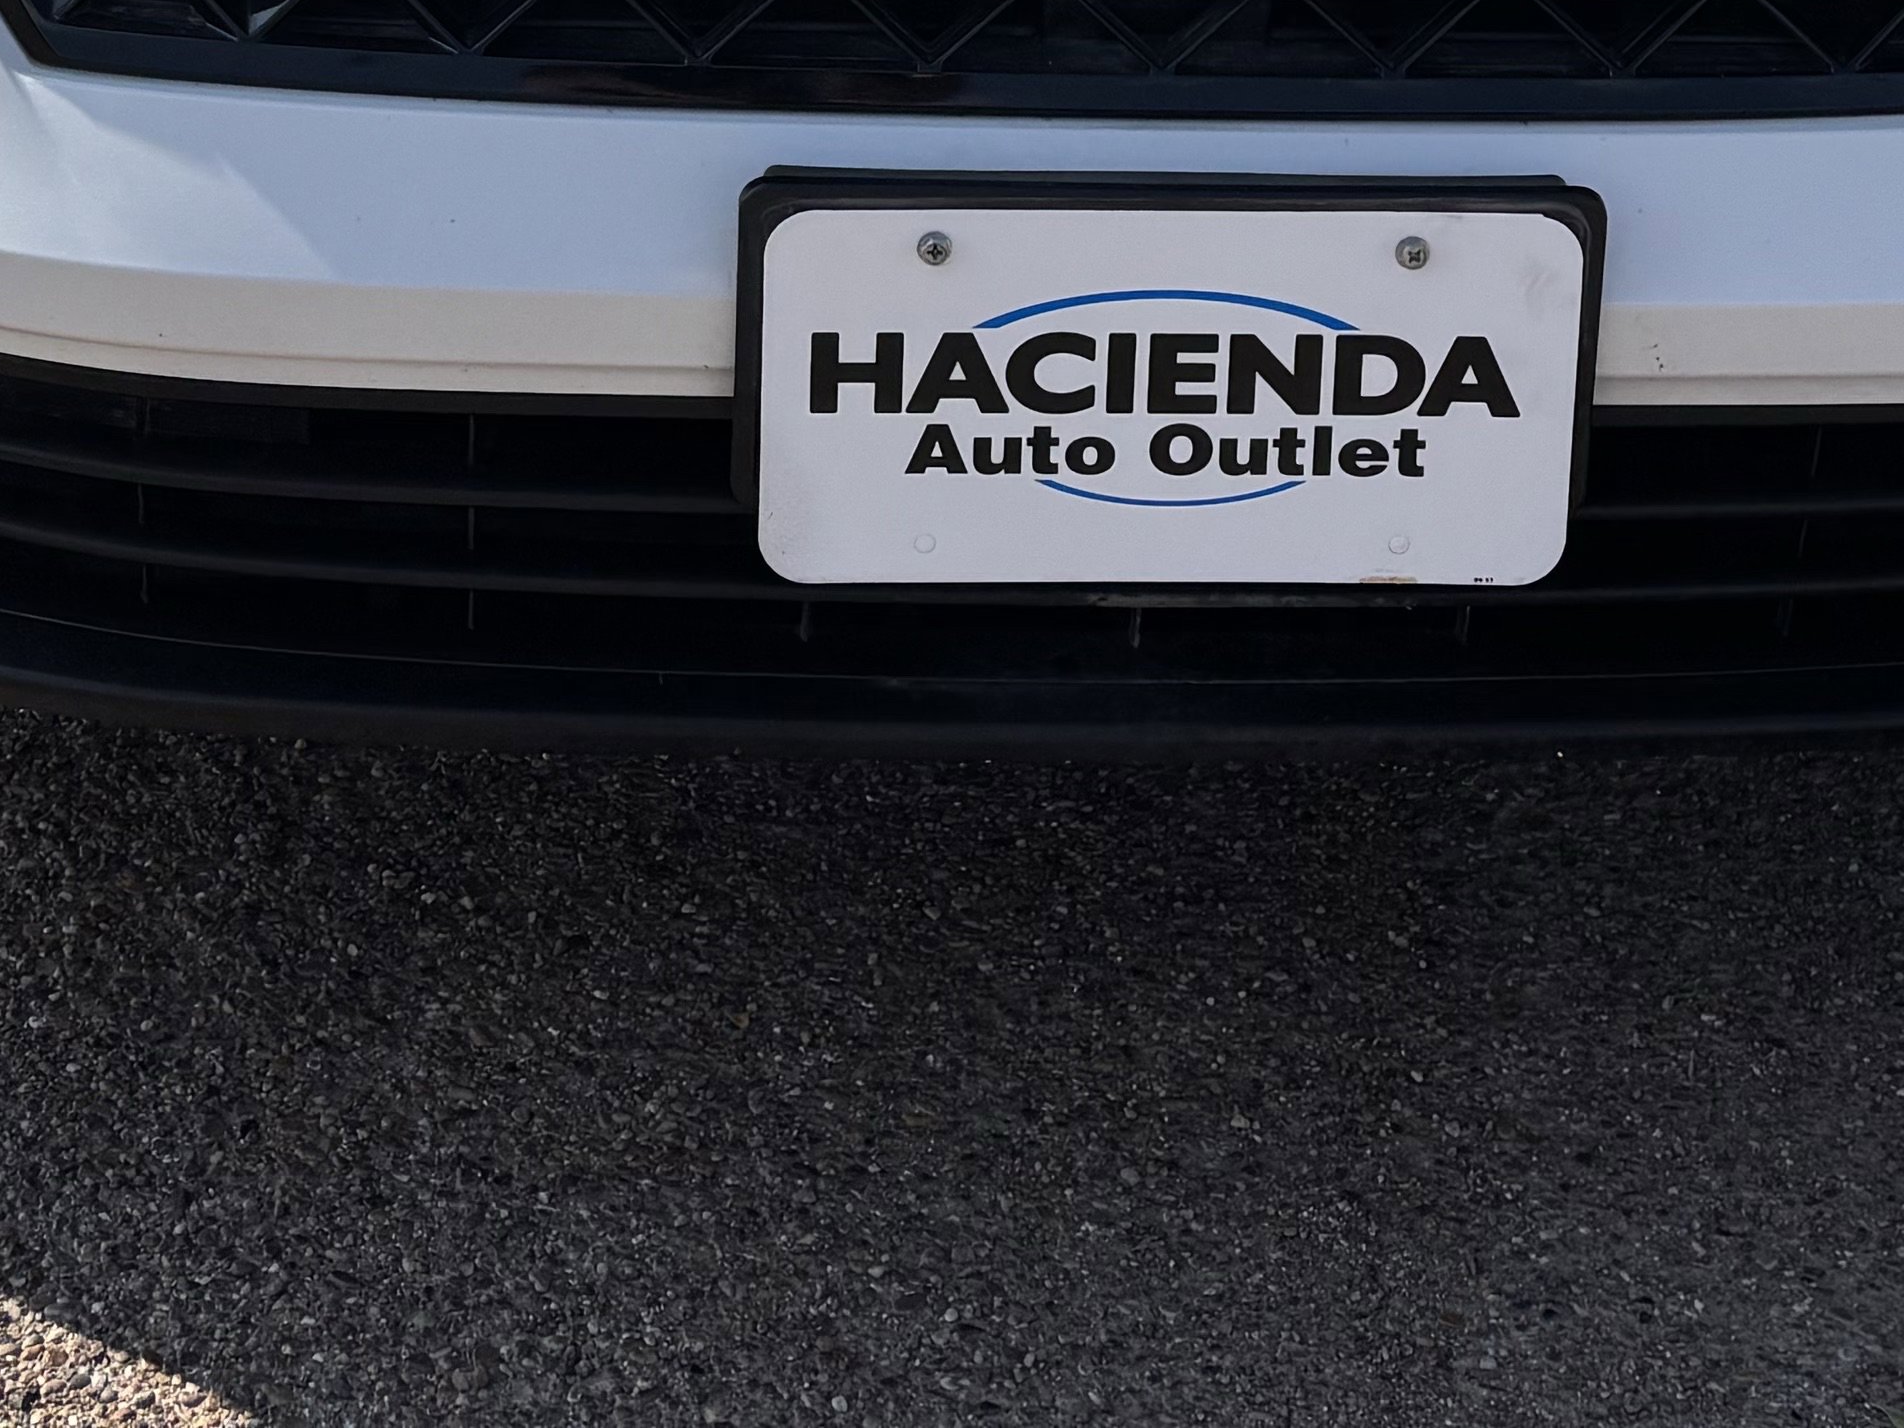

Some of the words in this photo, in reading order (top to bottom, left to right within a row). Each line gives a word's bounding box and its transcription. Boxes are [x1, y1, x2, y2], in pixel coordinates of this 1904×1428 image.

[809, 331, 1521, 418] HACIENDA
[904, 423, 1117, 476] Auto
[1148, 422, 1427, 478] Outlet
